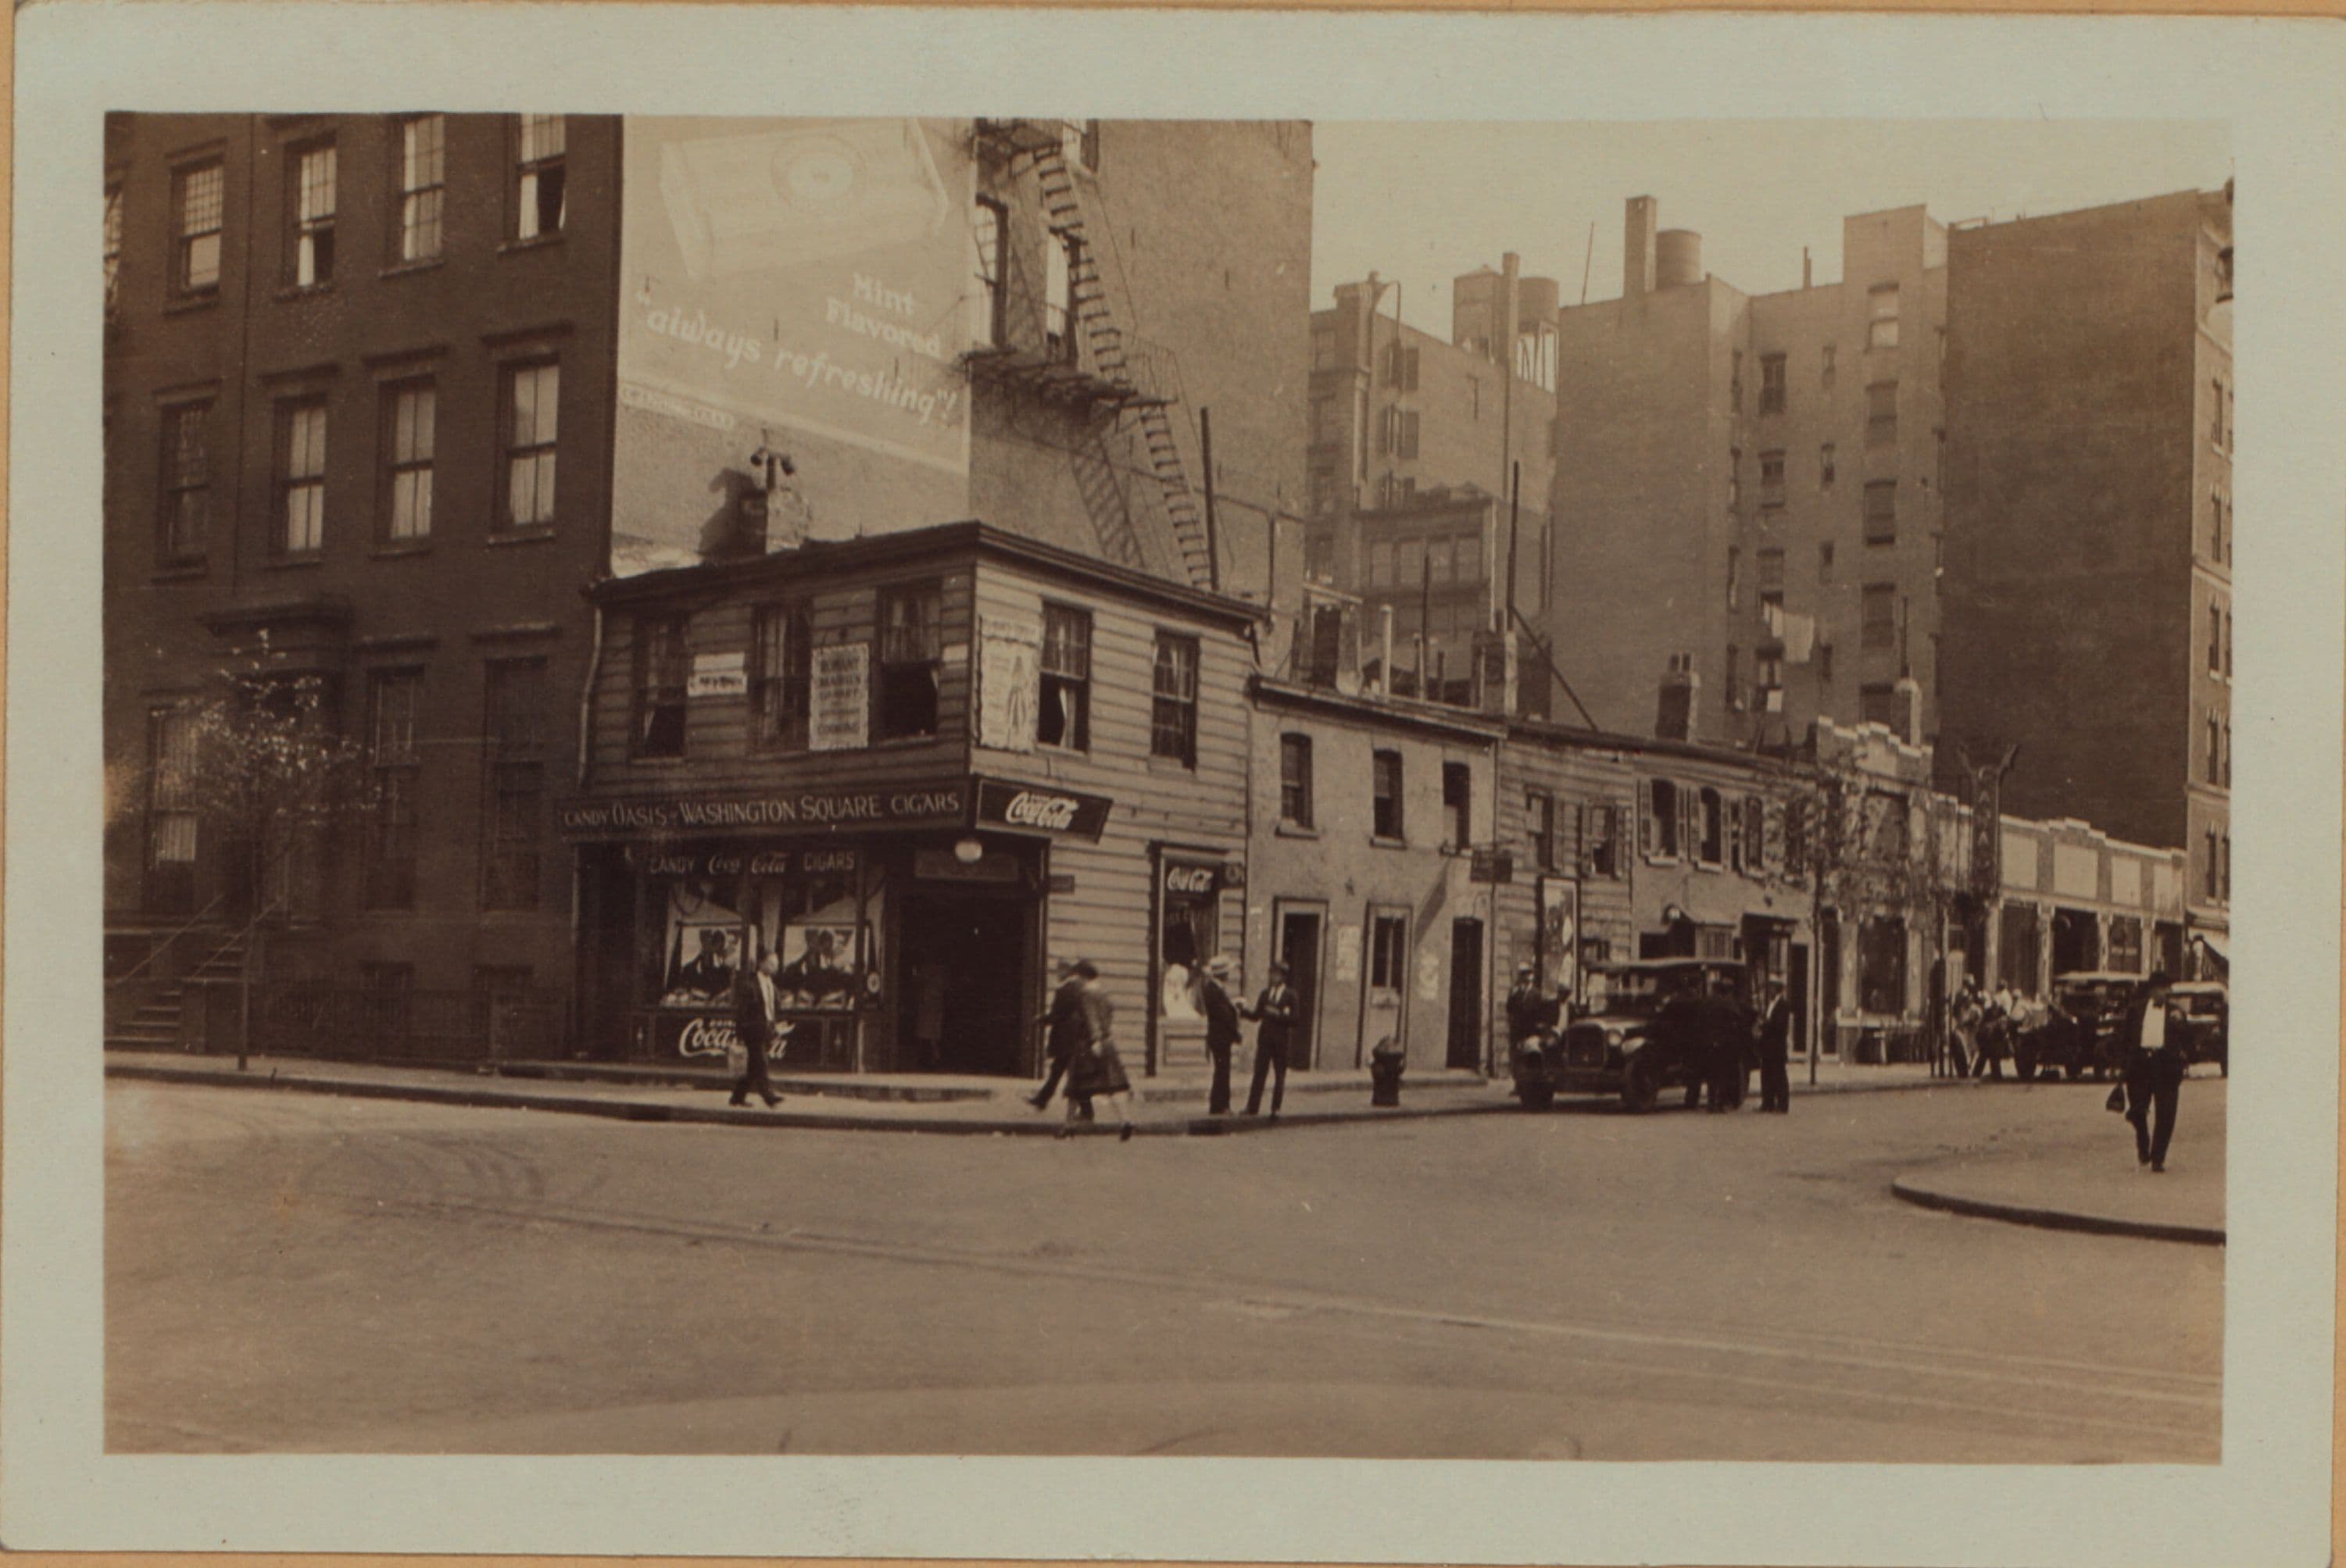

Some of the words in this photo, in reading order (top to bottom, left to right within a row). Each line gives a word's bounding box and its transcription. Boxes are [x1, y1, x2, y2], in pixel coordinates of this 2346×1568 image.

[853, 271, 915, 316] Mint
[825, 296, 941, 359] Flavored
[564, 809, 610, 827] CANDY
[678, 799, 796, 825] WASHINGTON
[799, 795, 882, 822] SQUARE
[890, 792, 960, 815] CIGARS
[803, 851, 855, 872] CIGARS
